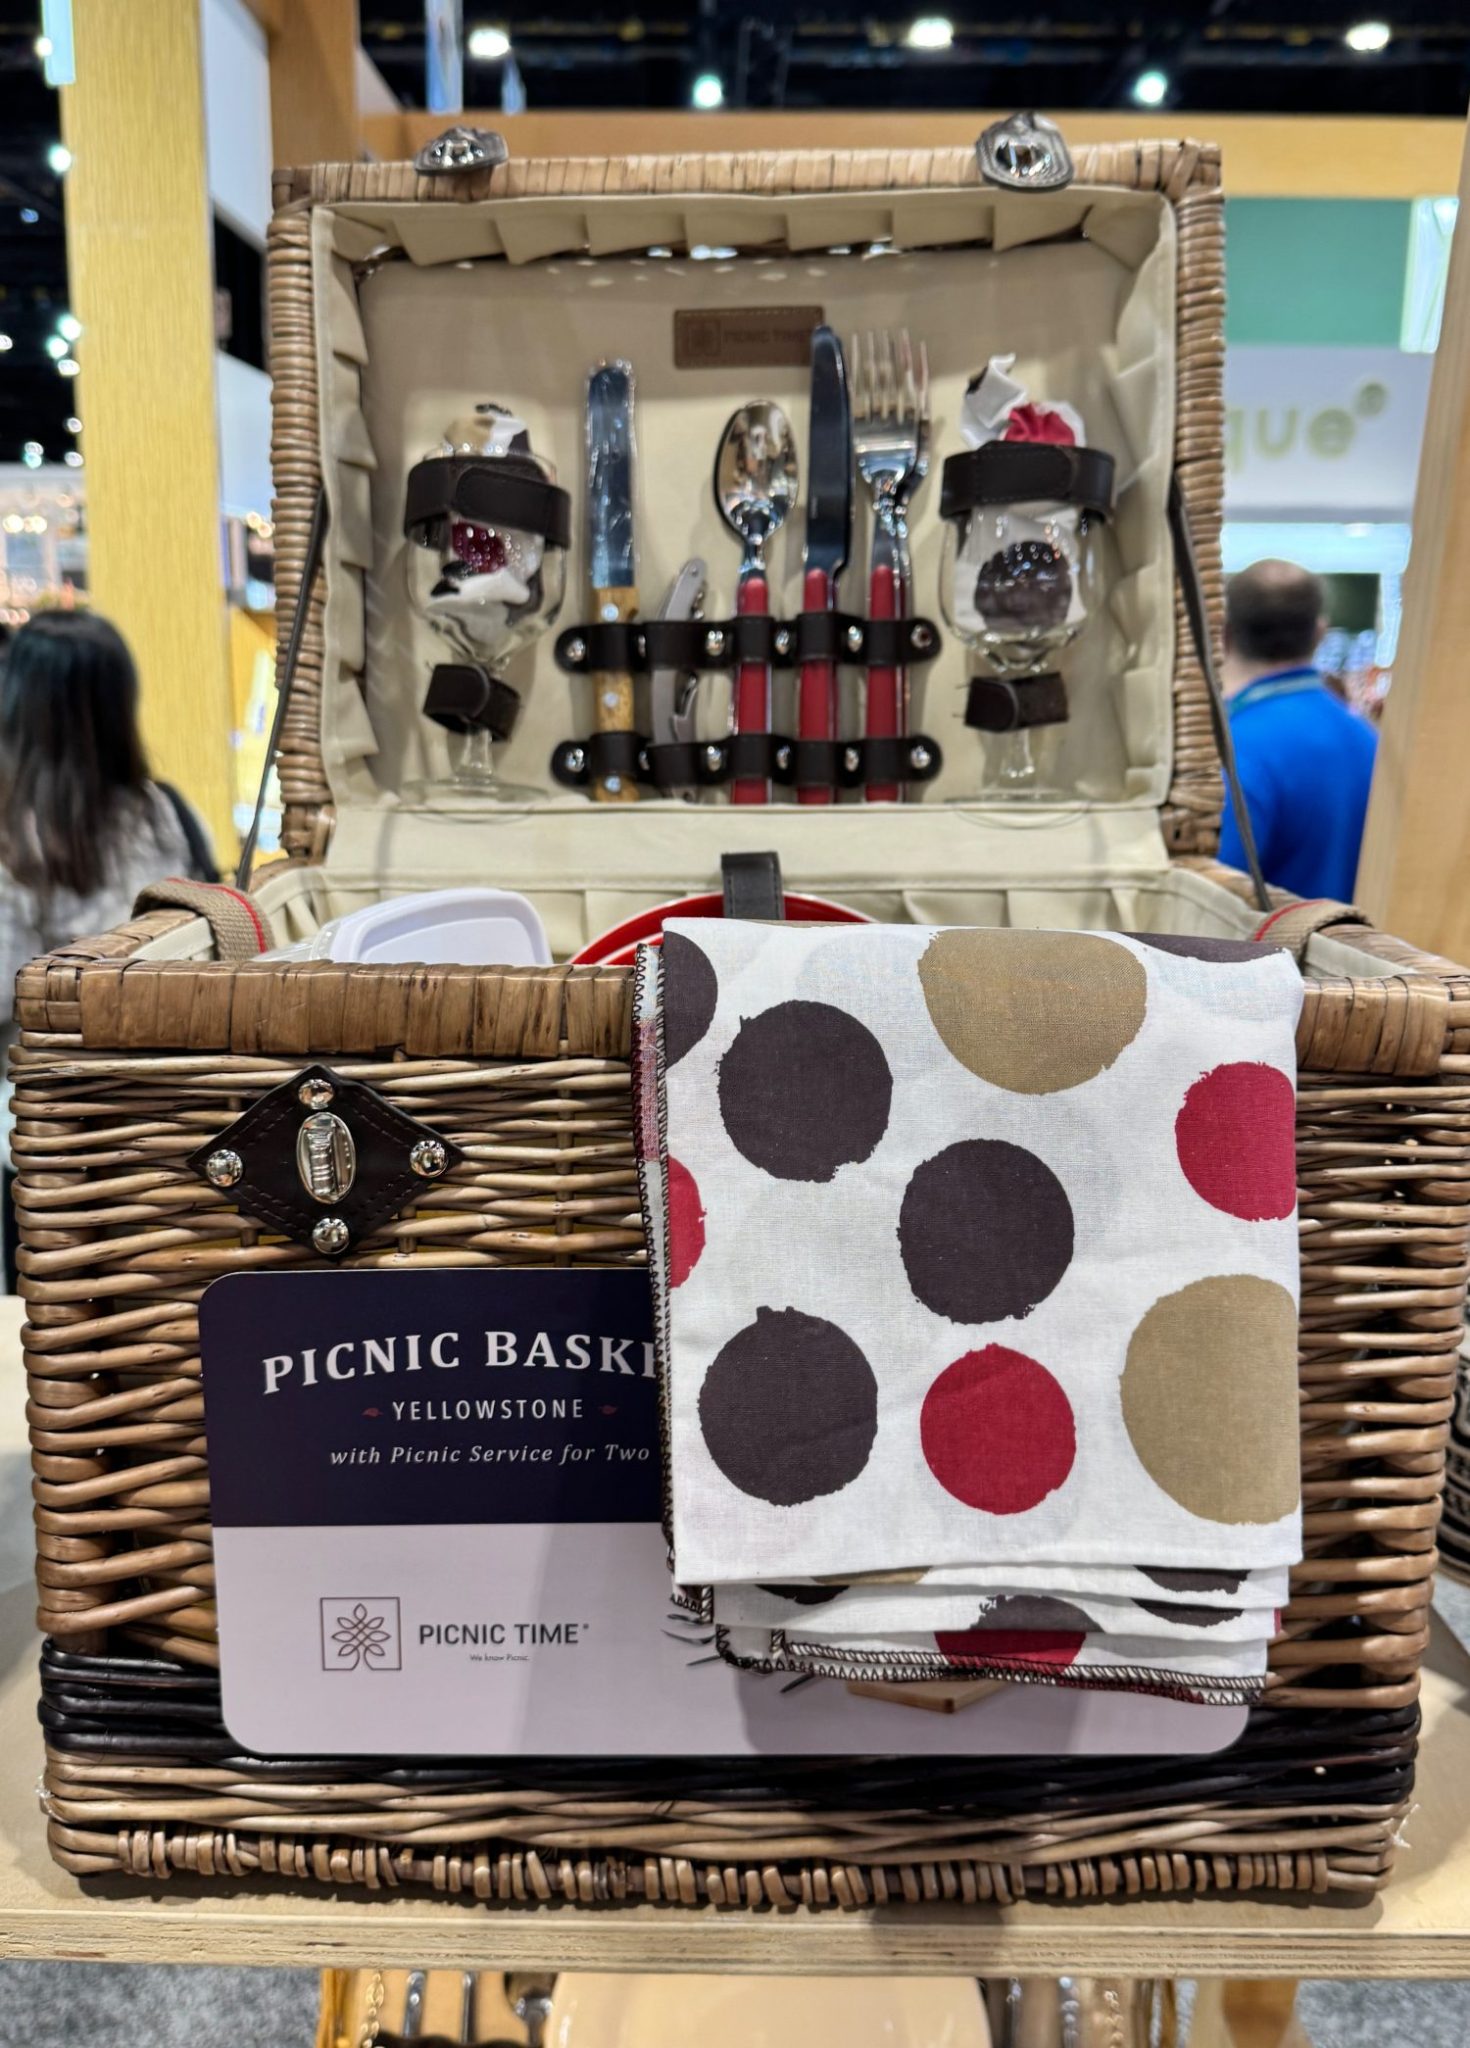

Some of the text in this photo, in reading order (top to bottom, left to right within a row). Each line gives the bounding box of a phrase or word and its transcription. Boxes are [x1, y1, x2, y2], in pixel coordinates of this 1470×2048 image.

[262, 1332, 460, 1395] PICNIC
[392, 1399, 583, 1421] YELLOWSTONE
[330, 1443, 650, 1466] with Picnic Service for Two
[419, 1623, 506, 1645] PICNIC
